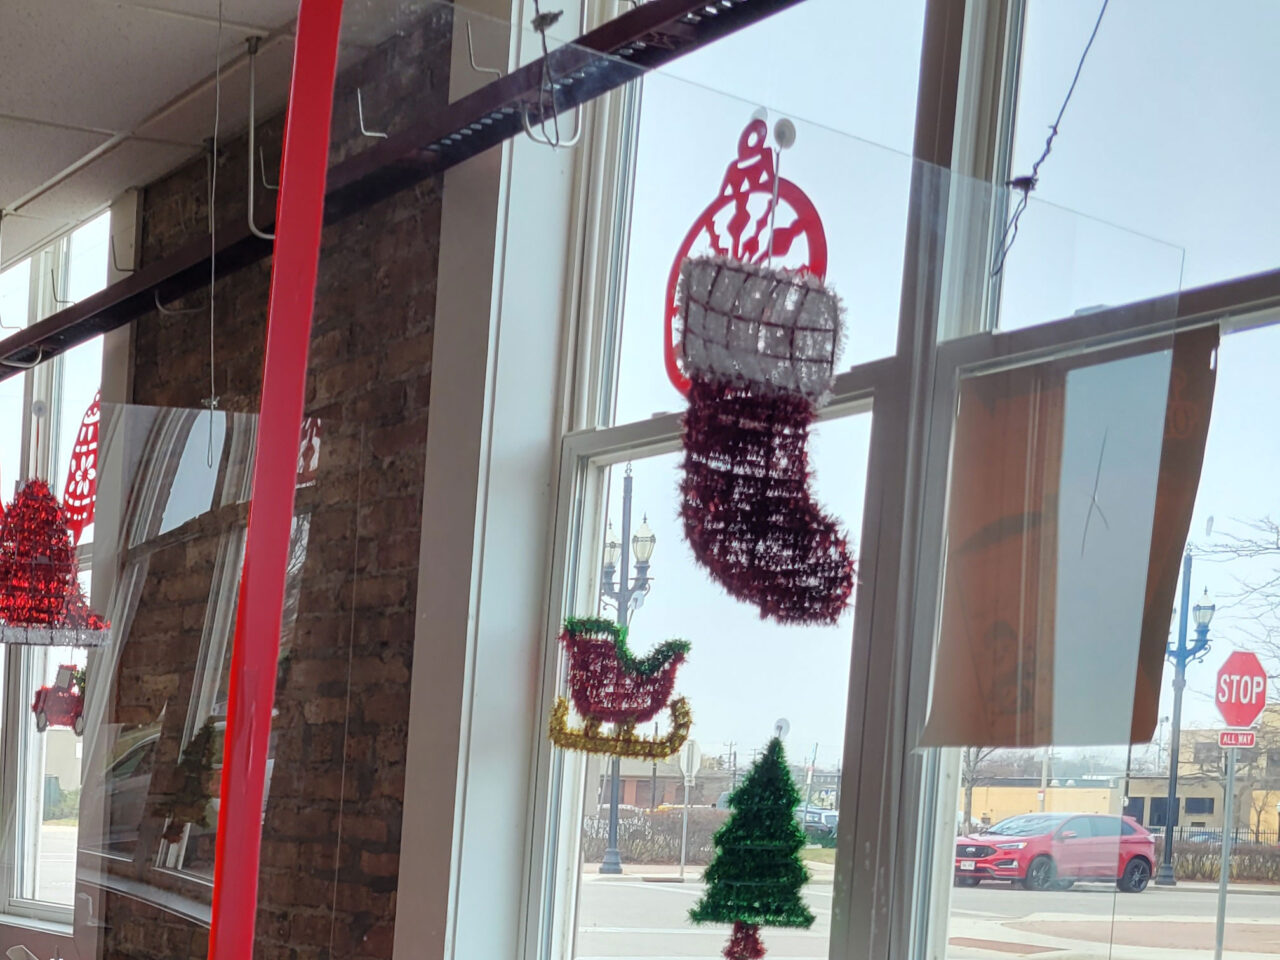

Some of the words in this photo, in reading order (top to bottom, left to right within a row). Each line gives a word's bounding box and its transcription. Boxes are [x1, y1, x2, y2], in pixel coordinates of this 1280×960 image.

[1218, 674, 1264, 704] STOP
[1223, 734, 1236, 744] ALL
[1237, 734, 1252, 745] WAY
